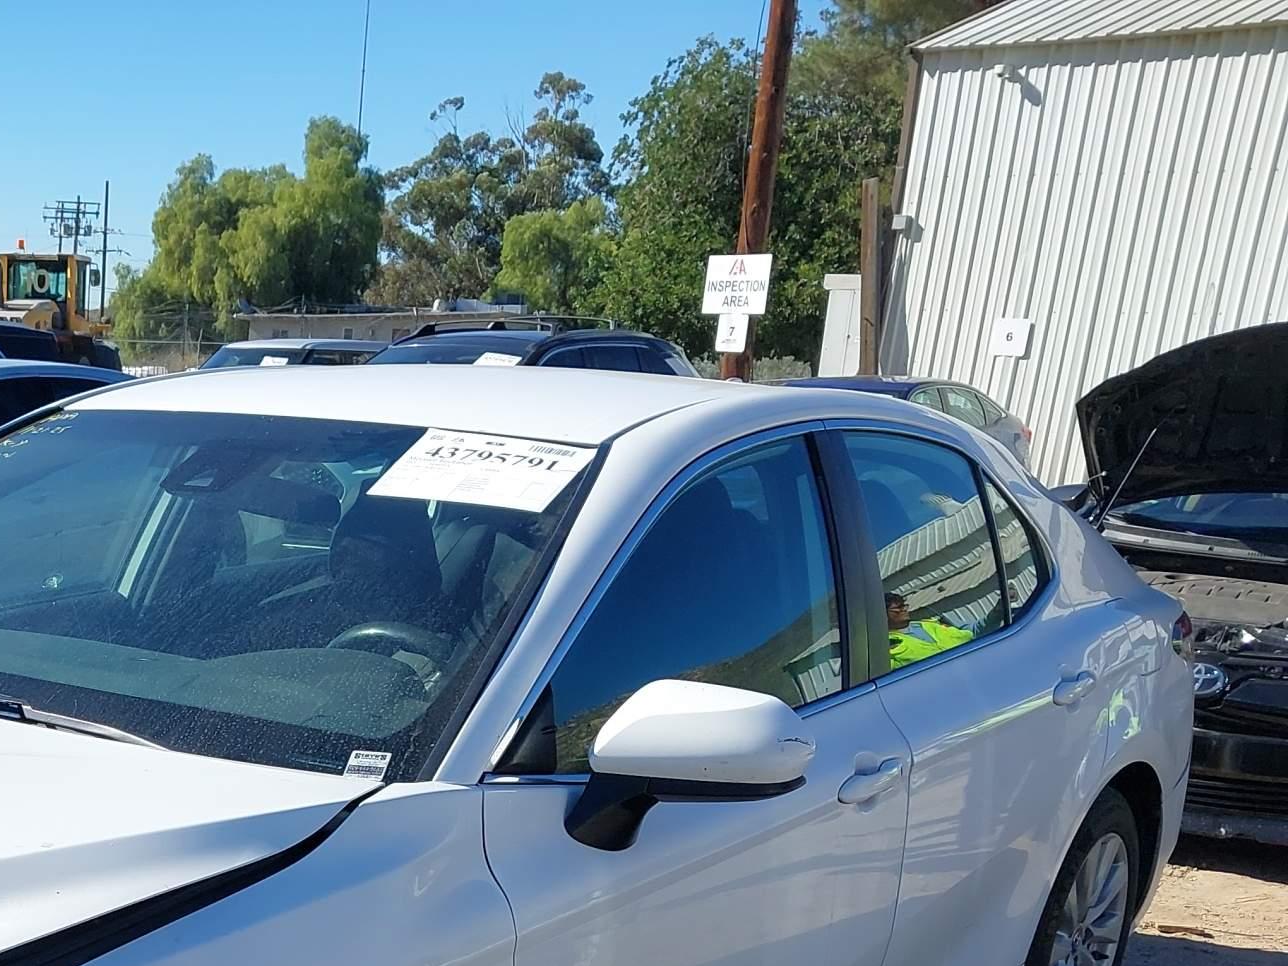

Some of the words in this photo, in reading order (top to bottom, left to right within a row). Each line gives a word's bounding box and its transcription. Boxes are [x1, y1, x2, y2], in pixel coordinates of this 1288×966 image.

[707, 279, 766, 292] INSPECTION
[721, 295, 749, 307] AREA
[729, 326, 736, 337] 7
[1006, 332, 1013, 342] 6
[424, 445, 560, 471] 43795791
